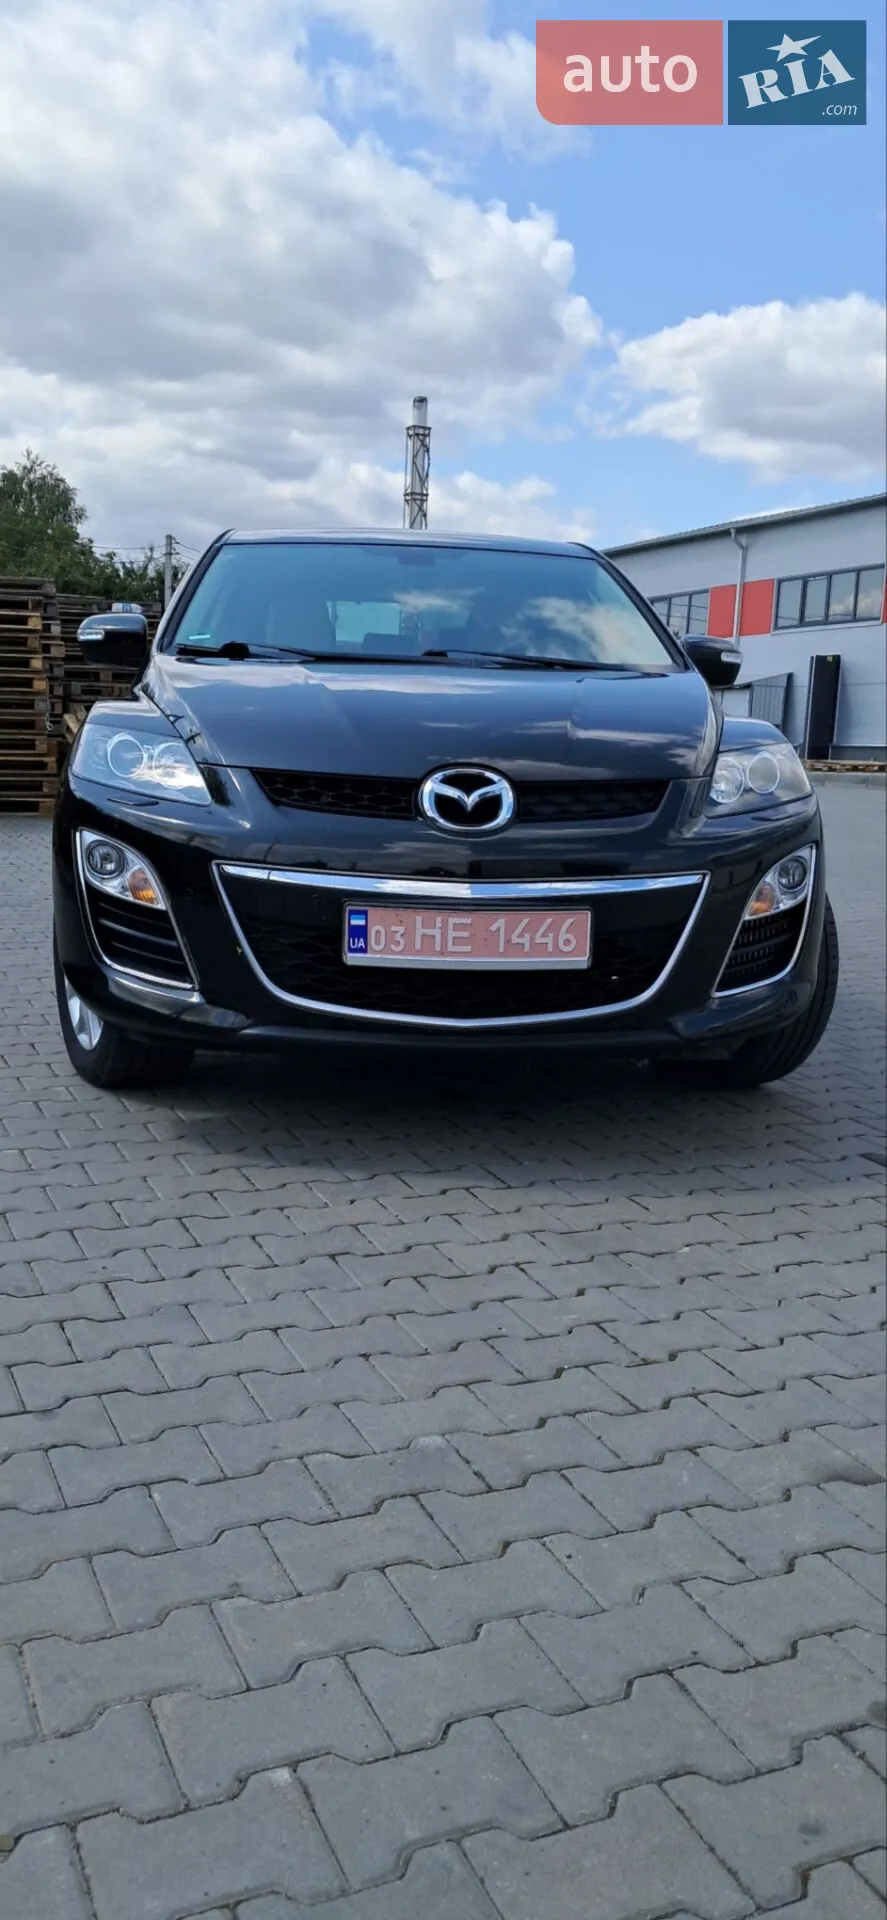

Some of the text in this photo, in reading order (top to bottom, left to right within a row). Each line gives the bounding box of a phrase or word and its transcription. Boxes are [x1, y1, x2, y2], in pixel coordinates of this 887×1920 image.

[350, 937, 366, 949] UA
[370, 916, 577, 953] 03 HE 1446
